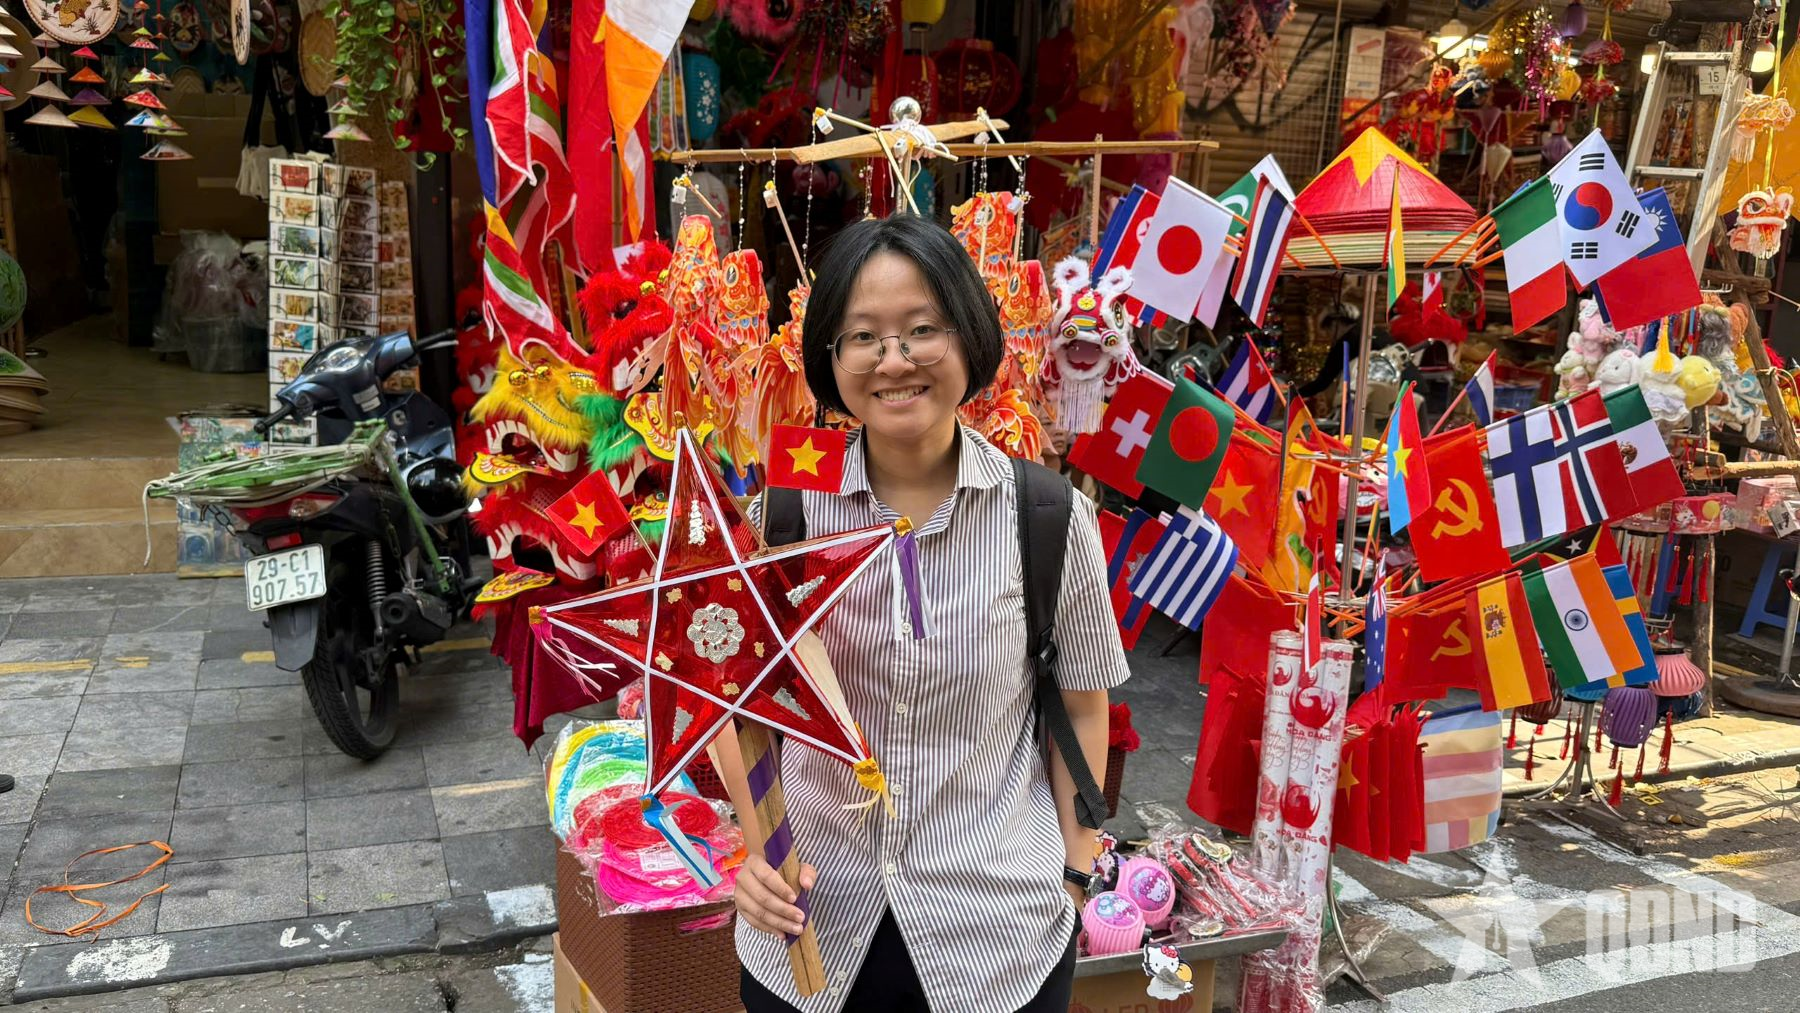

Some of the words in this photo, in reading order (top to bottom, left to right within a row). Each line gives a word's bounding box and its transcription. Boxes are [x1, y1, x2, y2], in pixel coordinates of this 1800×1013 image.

[1708, 72, 1720, 83] 15
[257, 550, 310, 581] 29-C1
[252, 572, 320, 606] 907.57
